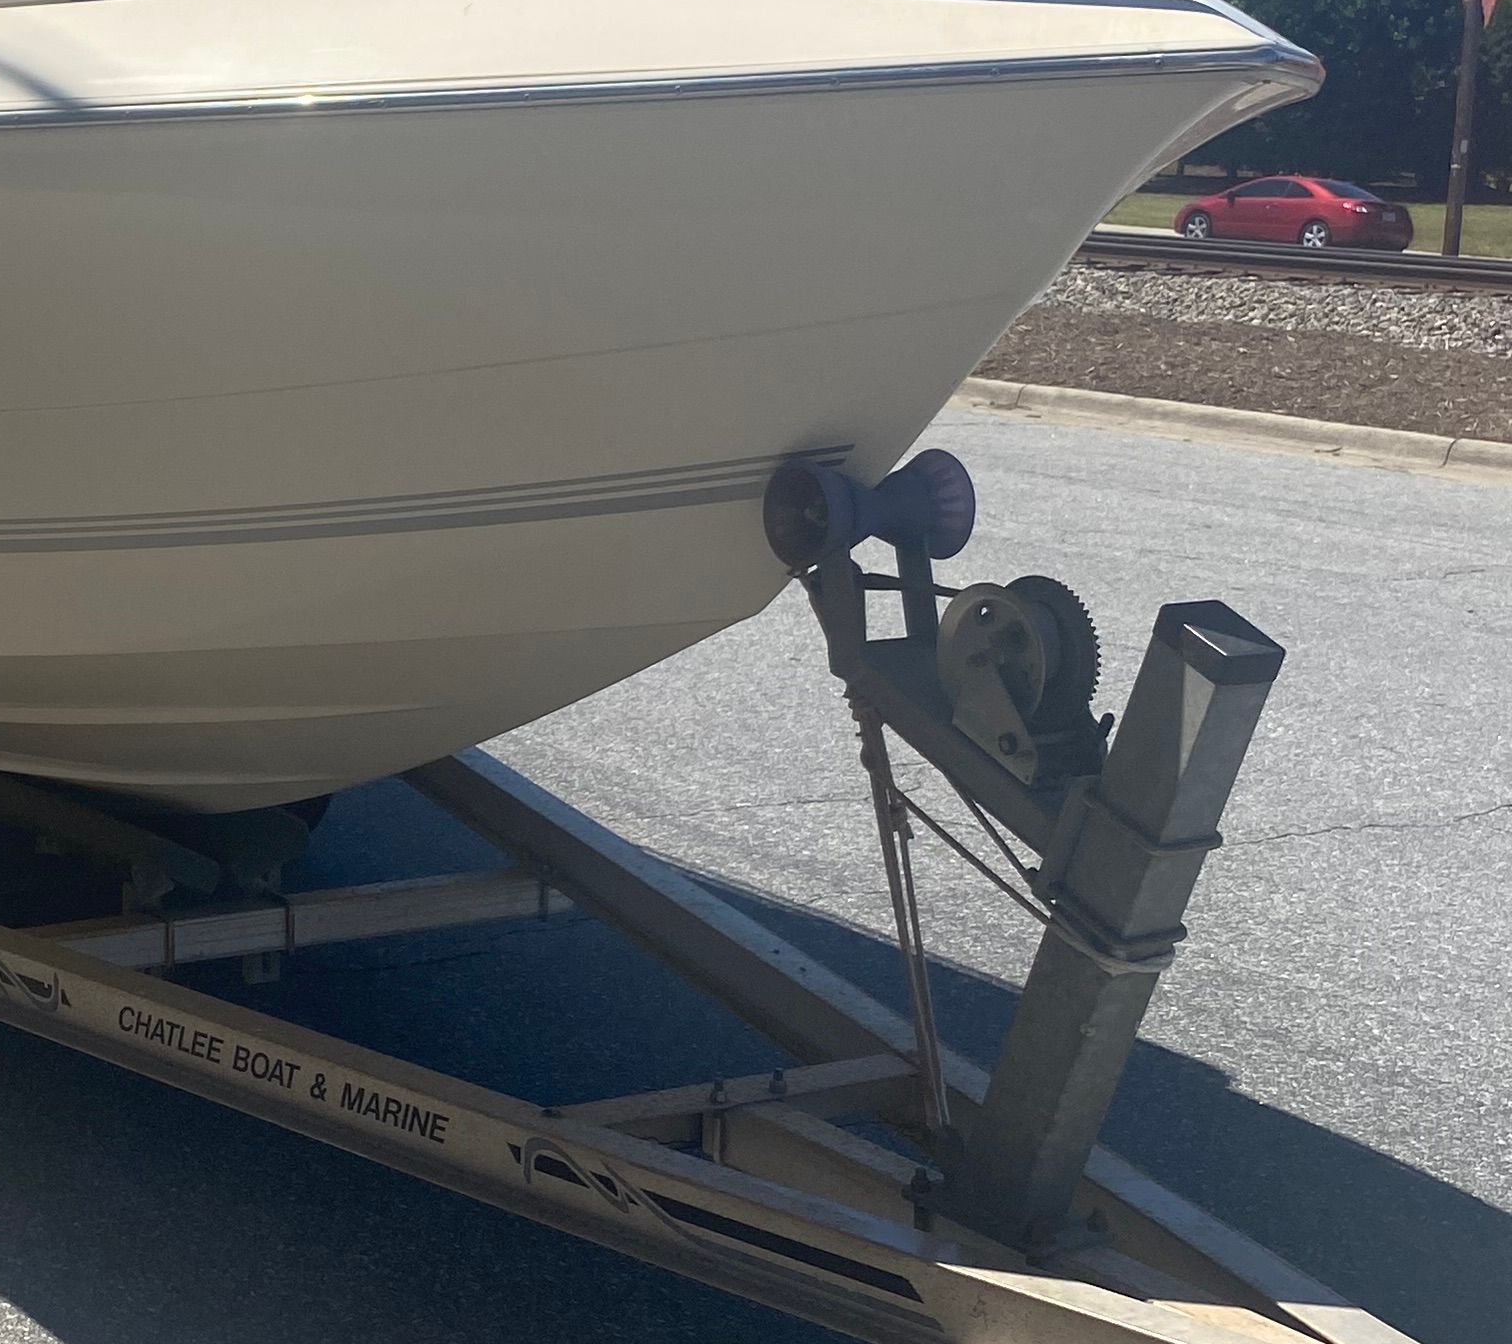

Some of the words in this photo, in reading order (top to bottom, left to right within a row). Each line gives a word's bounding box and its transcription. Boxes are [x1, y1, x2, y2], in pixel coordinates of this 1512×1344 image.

[119, 1006, 224, 1064] CHATLEE
[232, 1044, 301, 1089] BOAT
[310, 1073, 327, 1102] &
[340, 1083, 450, 1144] MARINE
